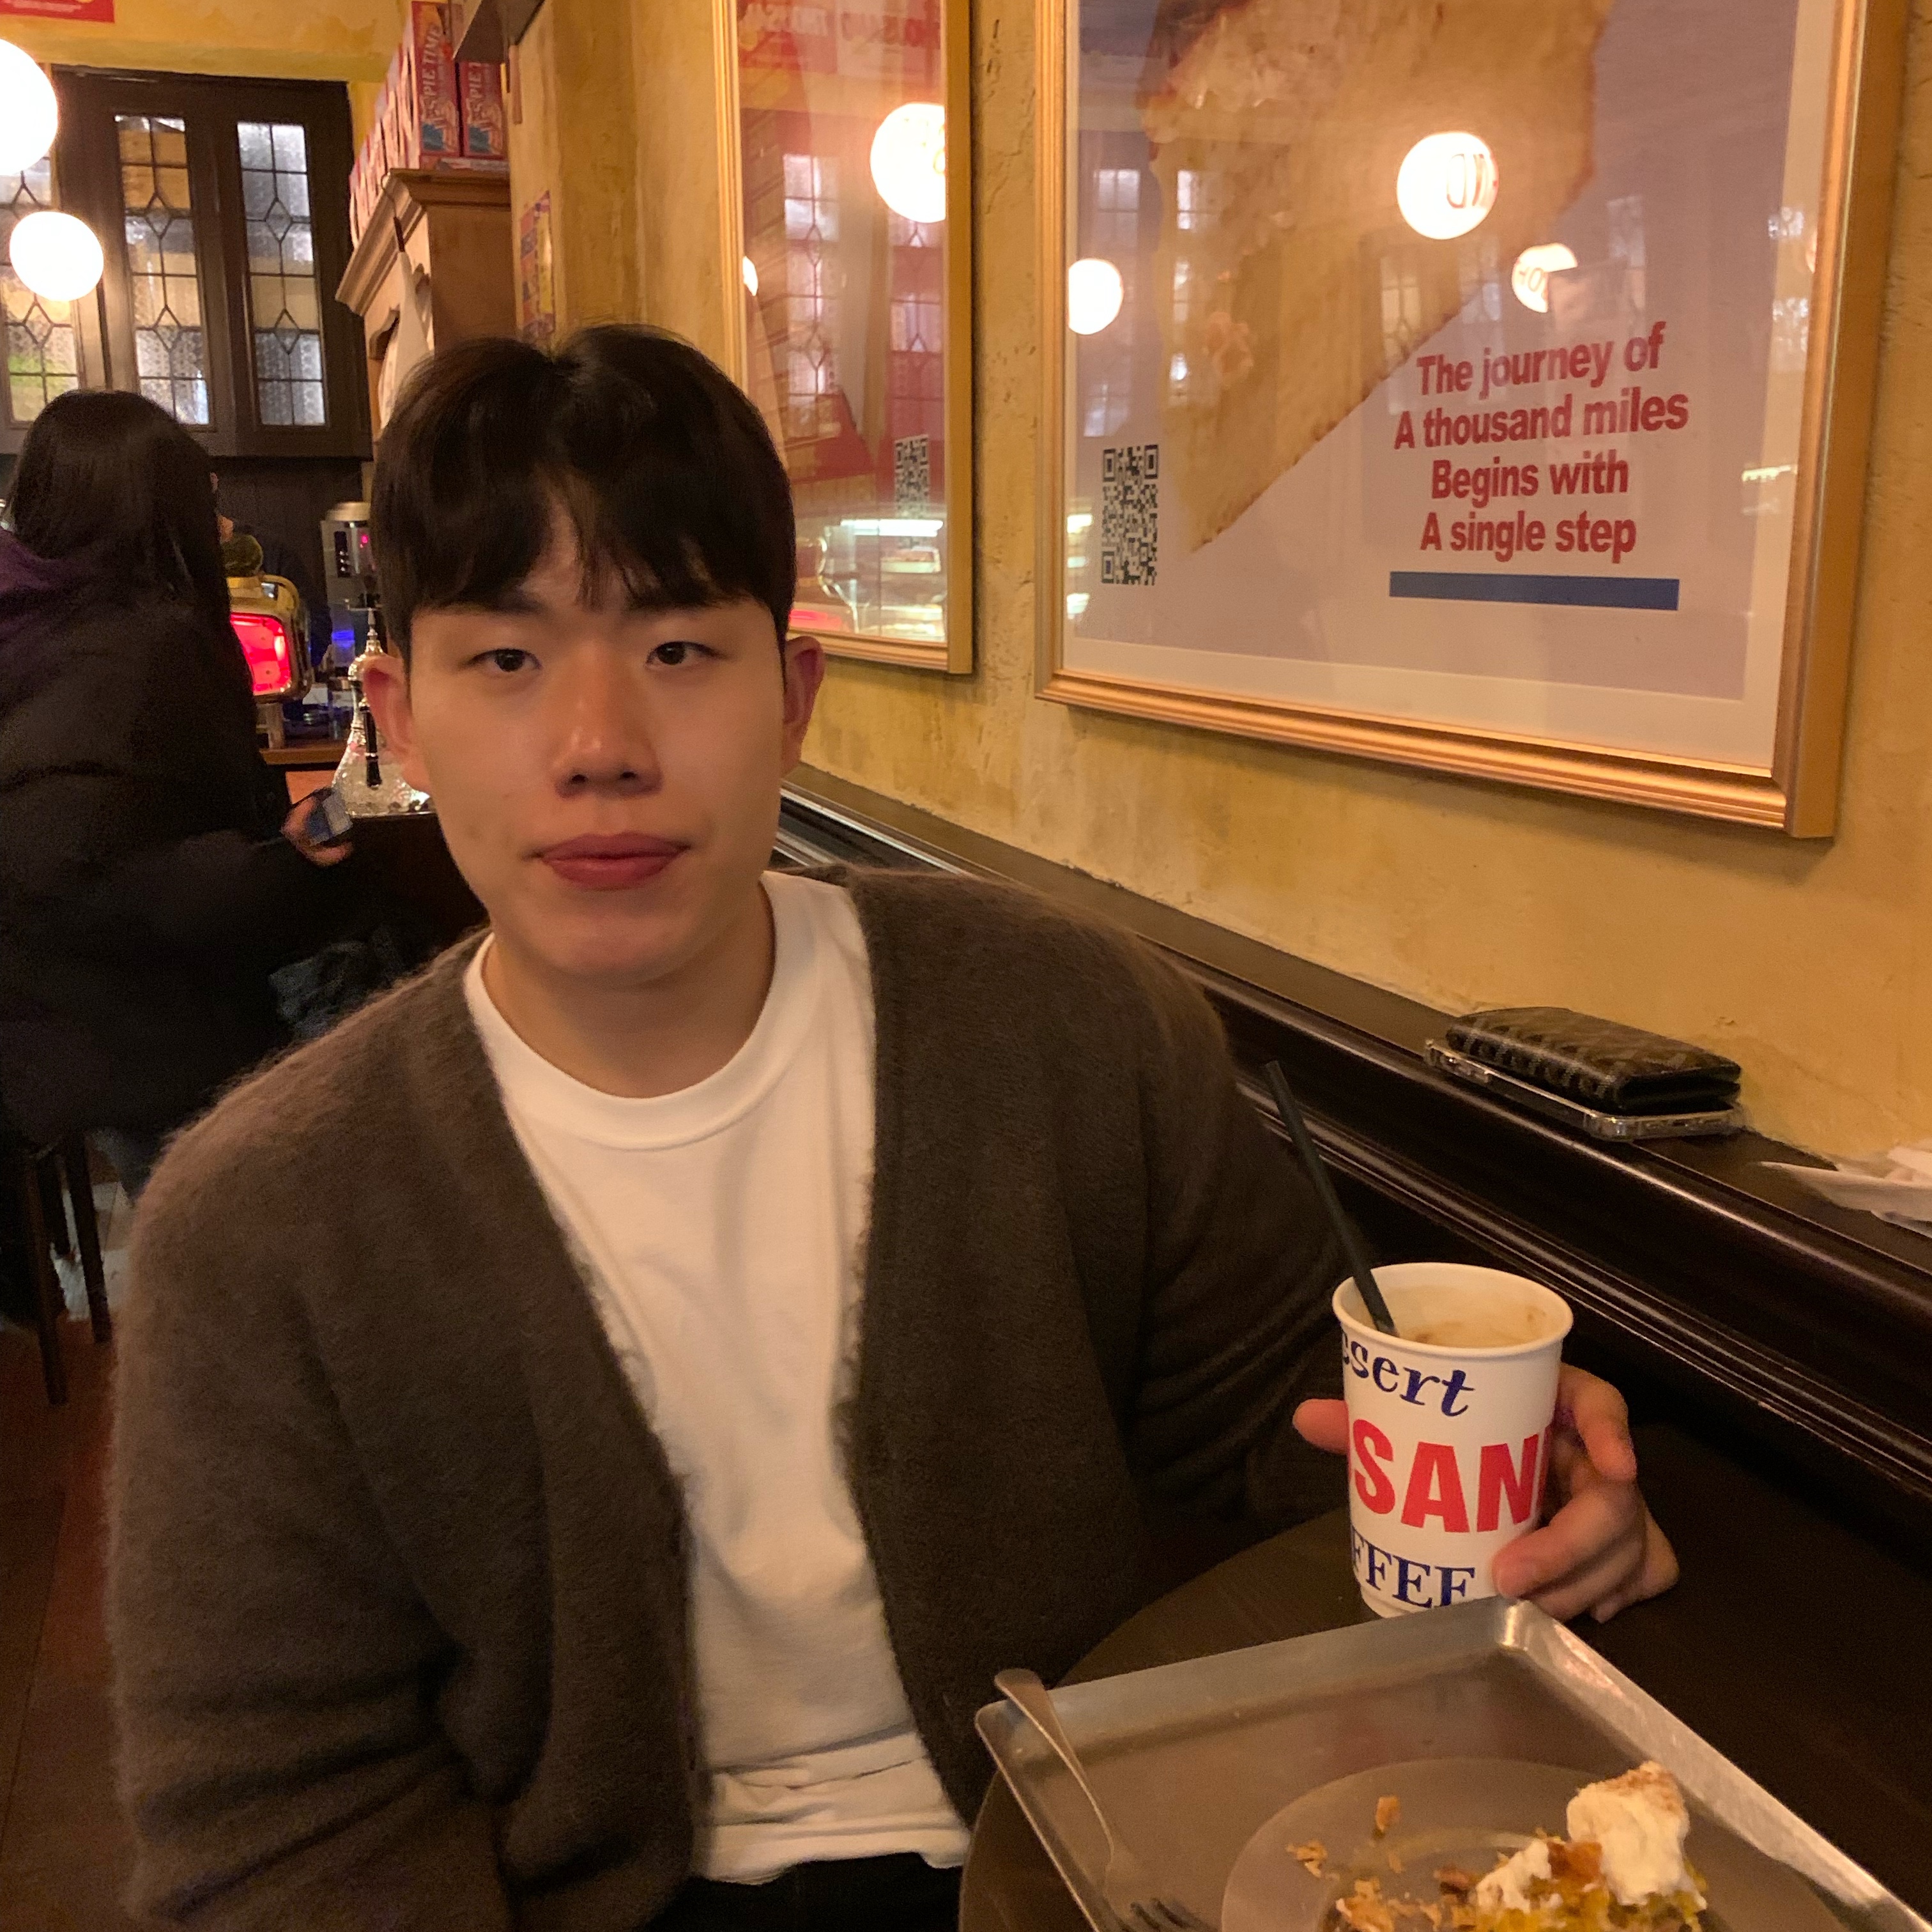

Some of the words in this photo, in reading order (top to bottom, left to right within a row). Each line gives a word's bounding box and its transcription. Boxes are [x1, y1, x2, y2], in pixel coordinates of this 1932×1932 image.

[422, 68, 437, 96] PIE
[1416, 354, 1473, 395] The
[1478, 341, 1614, 400] journey
[1623, 321, 1667, 372] of
[1393, 411, 1415, 450] A
[1423, 393, 1573, 448] thousand
[1583, 386, 1689, 436] miles
[1431, 456, 1539, 509] Begins
[1549, 448, 1629, 495] with
[1420, 512, 1443, 551] A
[1449, 510, 1546, 563] single
[1554, 510, 1637, 564] step
[1353, 1418, 1539, 1533] SAN
